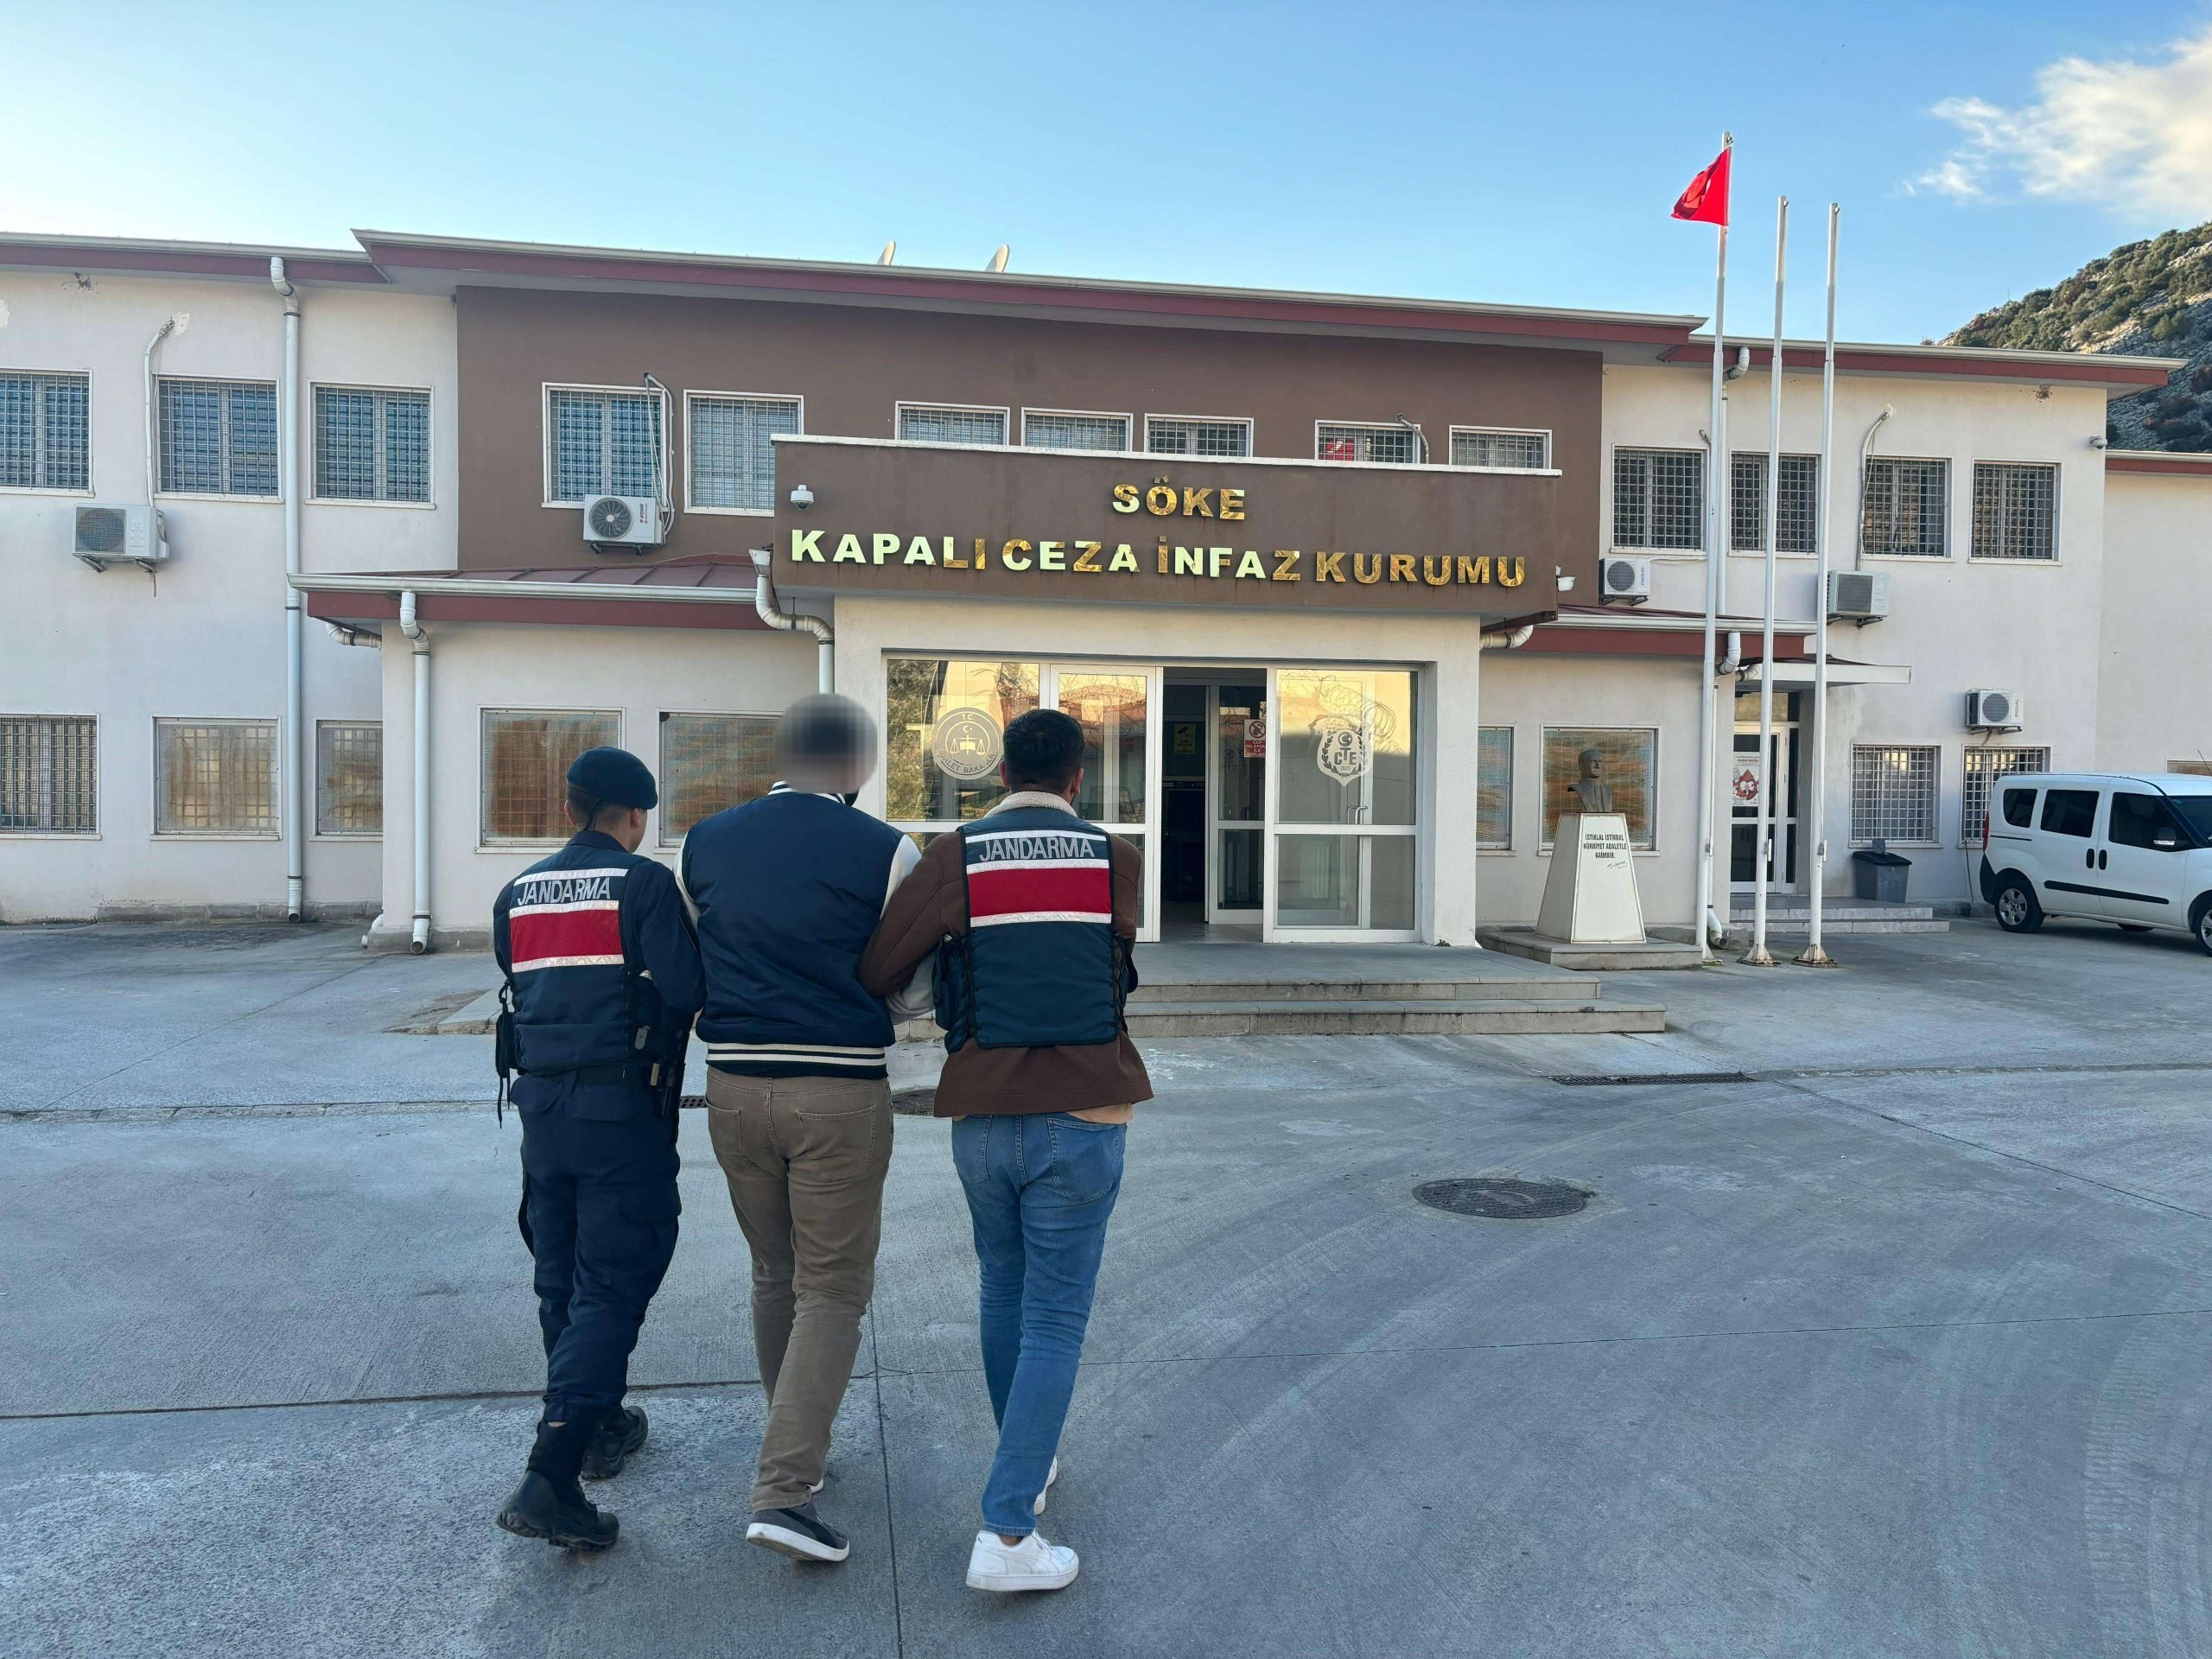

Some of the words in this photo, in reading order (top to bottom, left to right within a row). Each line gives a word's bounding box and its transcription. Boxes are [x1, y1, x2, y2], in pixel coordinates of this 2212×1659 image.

[1112, 475, 1244, 520] SÖKE
[791, 529, 987, 570] KAPALI
[1001, 538, 1141, 573] CEZA
[1157, 534, 1301, 581] İNFAZ
[1315, 550, 1526, 587] KURUMU
[1333, 747, 1357, 766] CTE
[979, 836, 1096, 862] JANDARMA
[517, 876, 611, 906] JANDARMA
